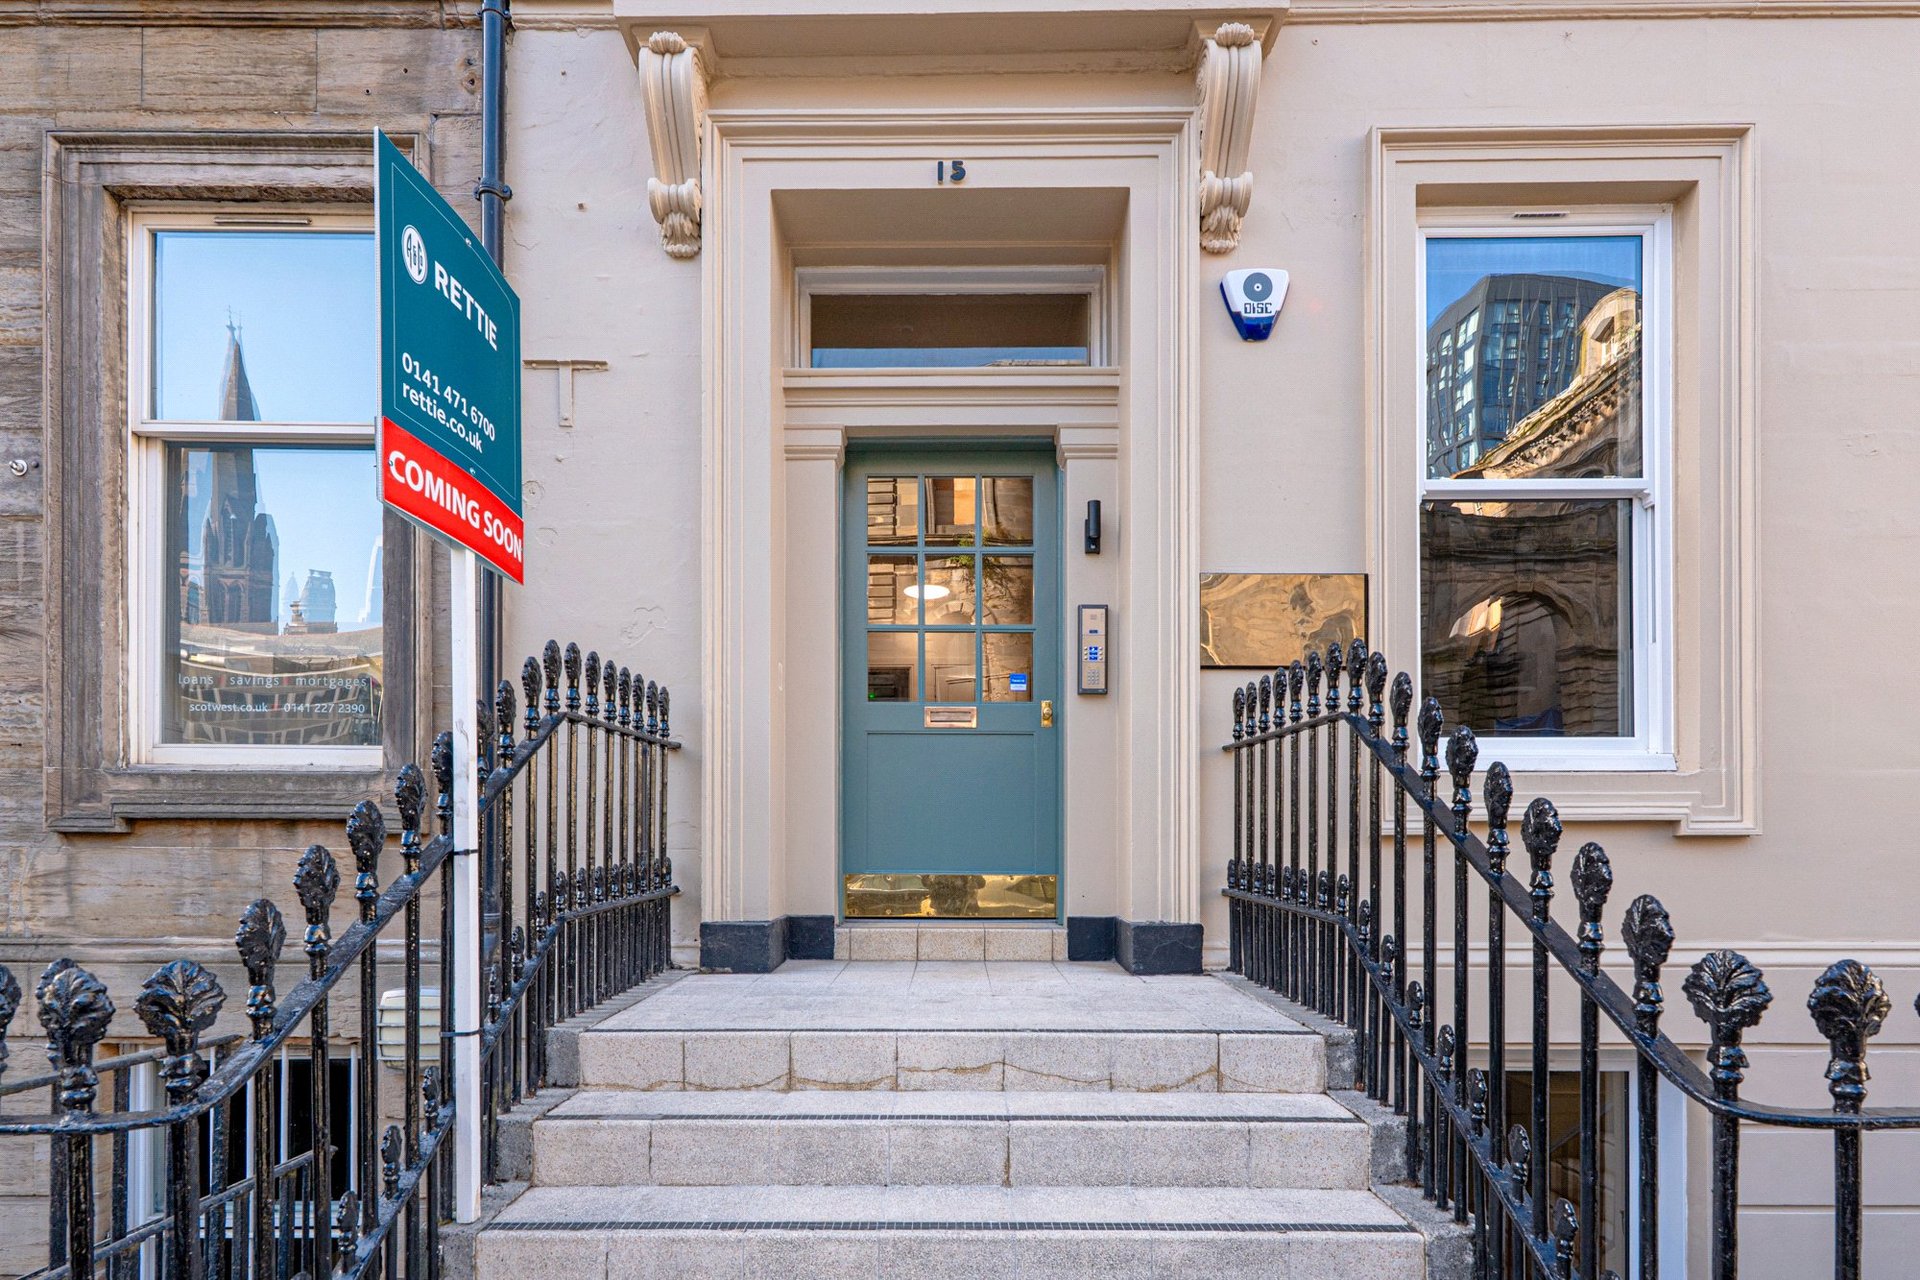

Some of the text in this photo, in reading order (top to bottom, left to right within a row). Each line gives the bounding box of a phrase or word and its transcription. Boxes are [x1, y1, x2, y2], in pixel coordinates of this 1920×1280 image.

[937, 160, 967, 182] 15
[434, 260, 498, 352] RETTIE
[1243, 302, 1273, 315] DISC
[402, 352, 495, 442] 0141 471 6700
[402, 382, 483, 454] rettie.co.uk
[388, 450, 523, 563] COMING SOON
[178, 673, 367, 690] loans savings mortgages
[189, 702, 366, 714] scotwest.co.uk 0141 227 2390
